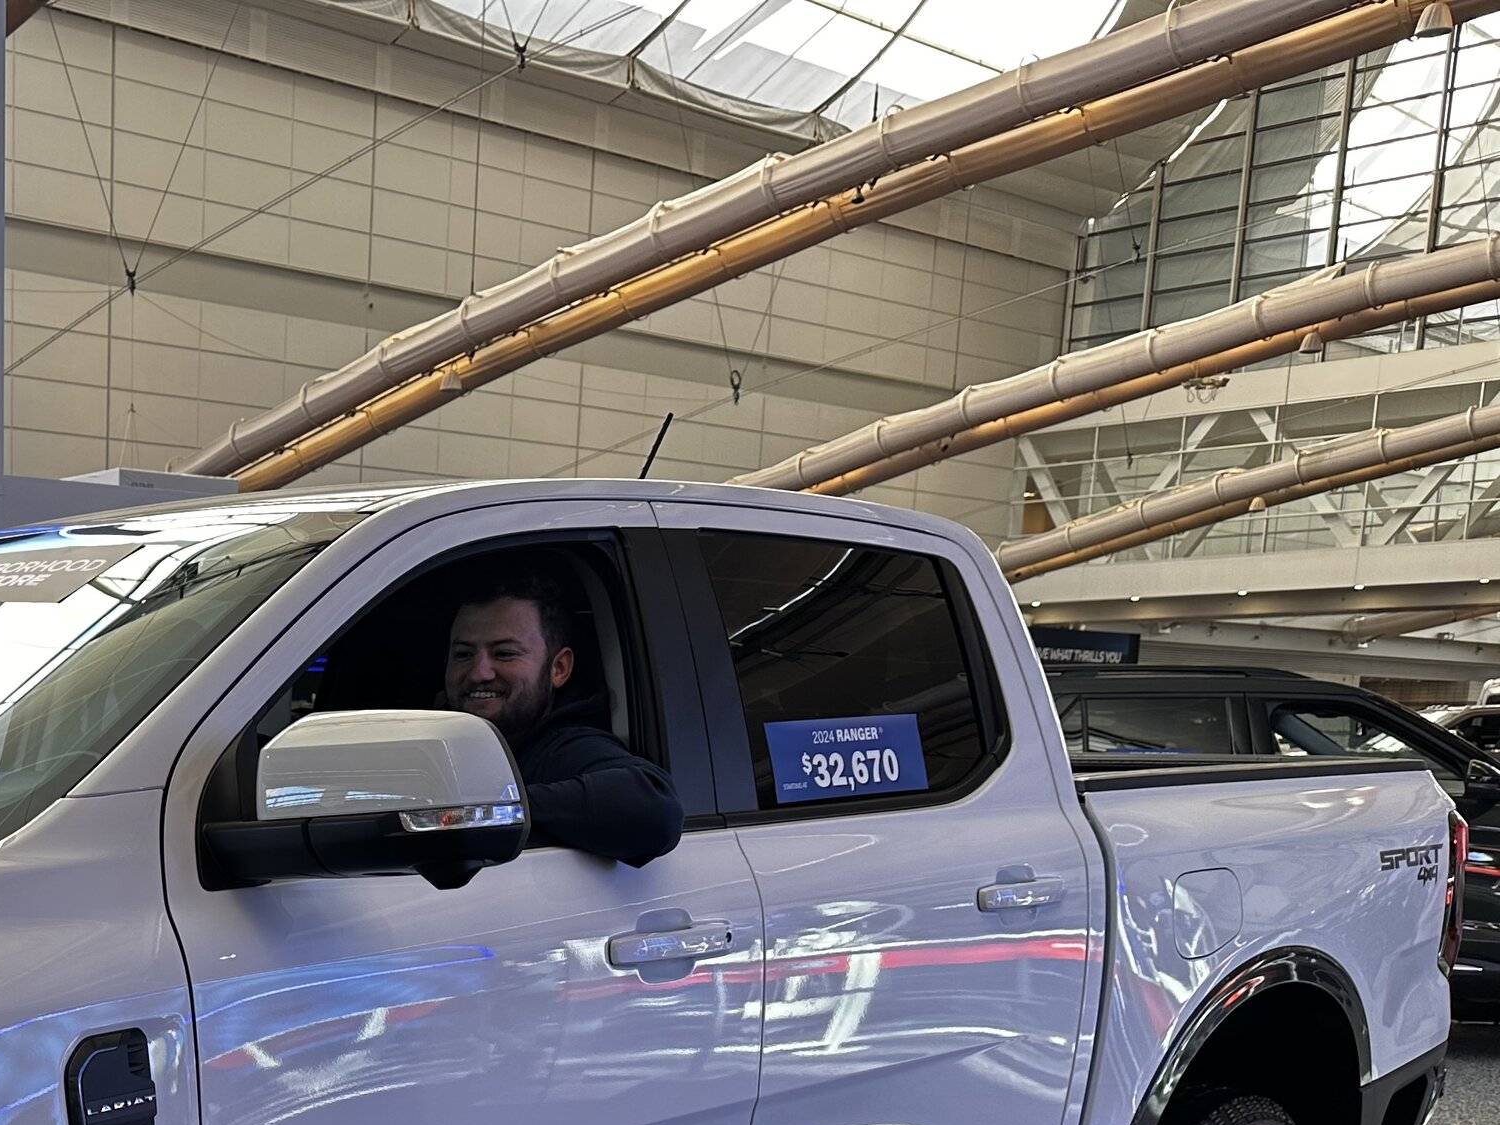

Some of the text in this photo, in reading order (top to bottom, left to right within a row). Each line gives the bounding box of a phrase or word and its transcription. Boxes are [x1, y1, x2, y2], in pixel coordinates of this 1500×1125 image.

[1050, 648, 1073, 662] WHAT
[1073, 649, 1104, 663] THRILLS
[1104, 651, 1123, 664] YOU
[811, 730, 835, 744] 2024
[801, 748, 899, 791] $32,670
[1380, 843, 1443, 871] SPORT
[86, 1094, 156, 1116] LARIAT
